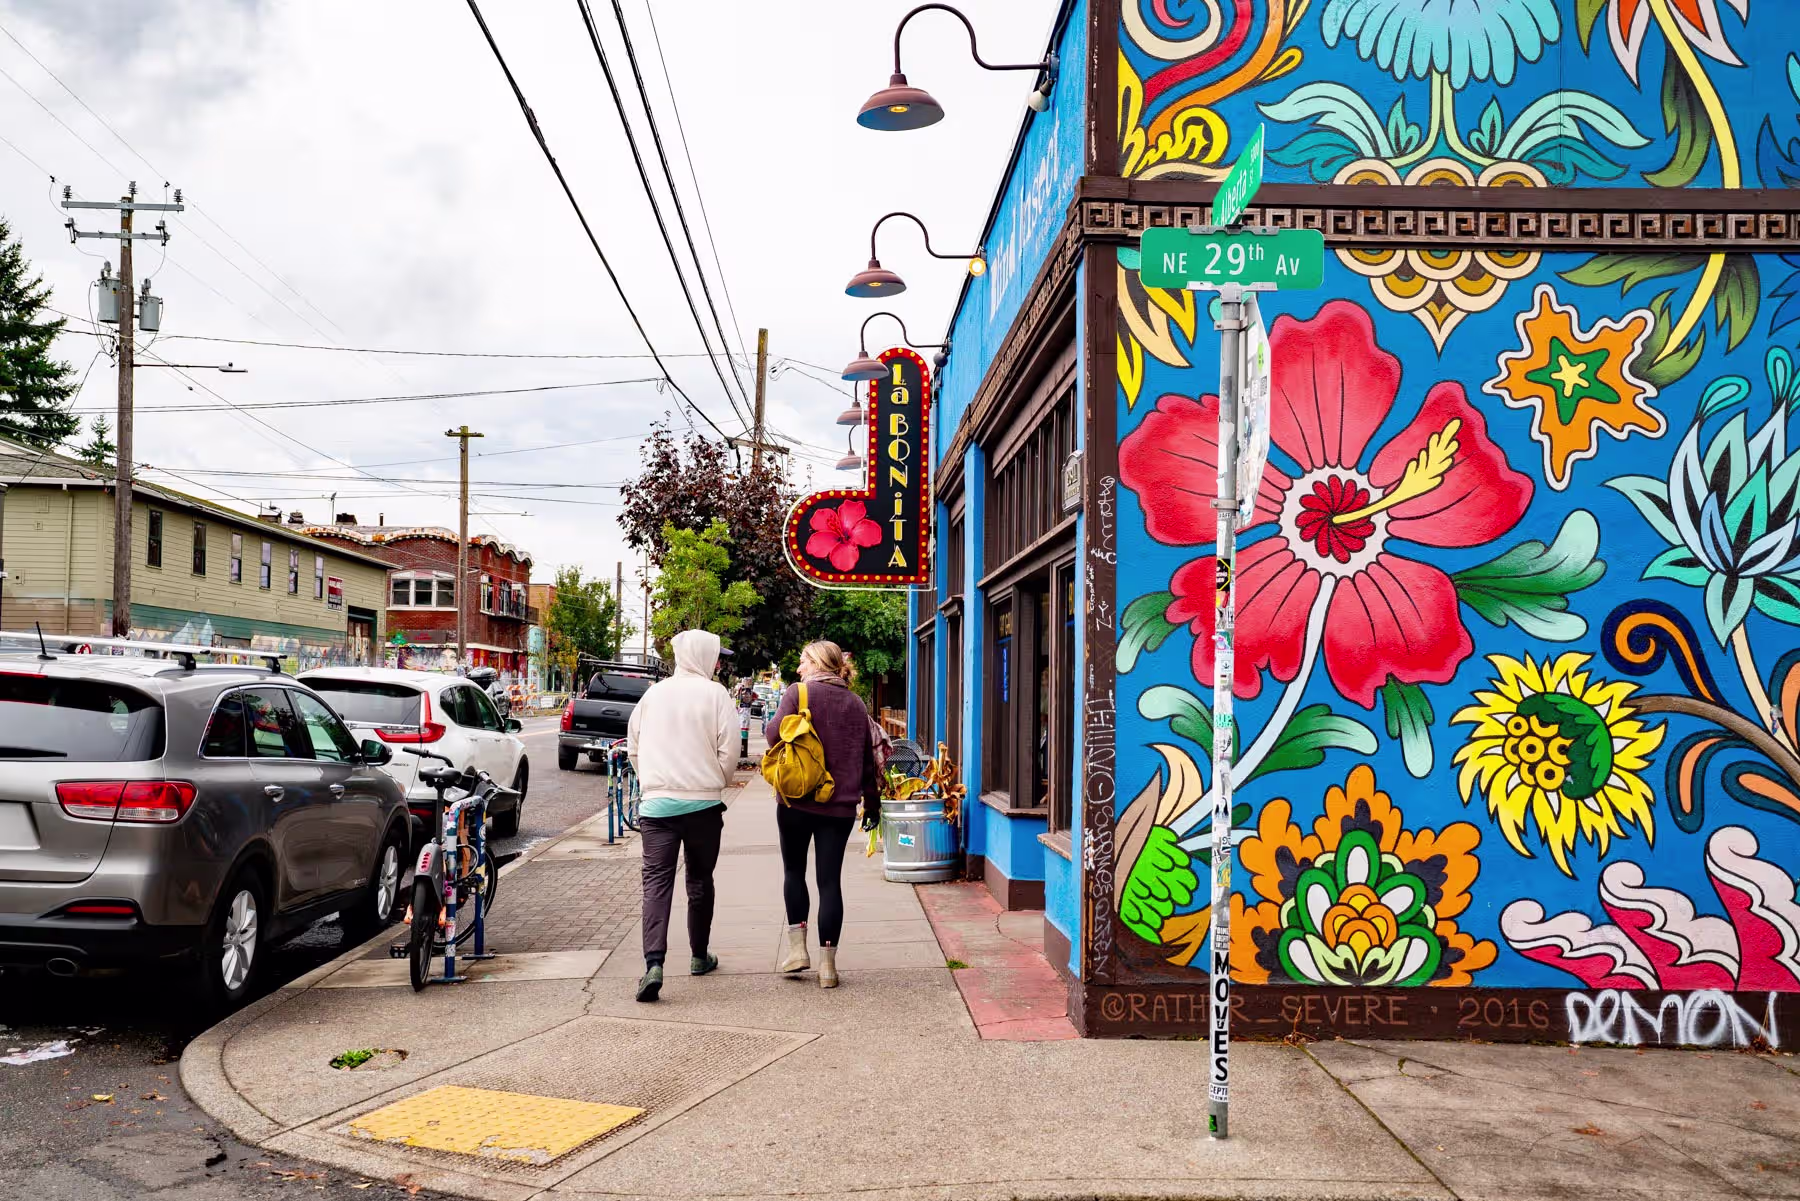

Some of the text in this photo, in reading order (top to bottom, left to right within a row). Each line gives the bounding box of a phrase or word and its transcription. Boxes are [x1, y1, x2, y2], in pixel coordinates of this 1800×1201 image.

[1220, 168, 1248, 227] Alberta
[1162, 242, 1300, 276] NE 29th Av
[1101, 992, 1550, 1029] @RATHR_SEVERE 2016
[1214, 951, 1229, 1082] MOVES
